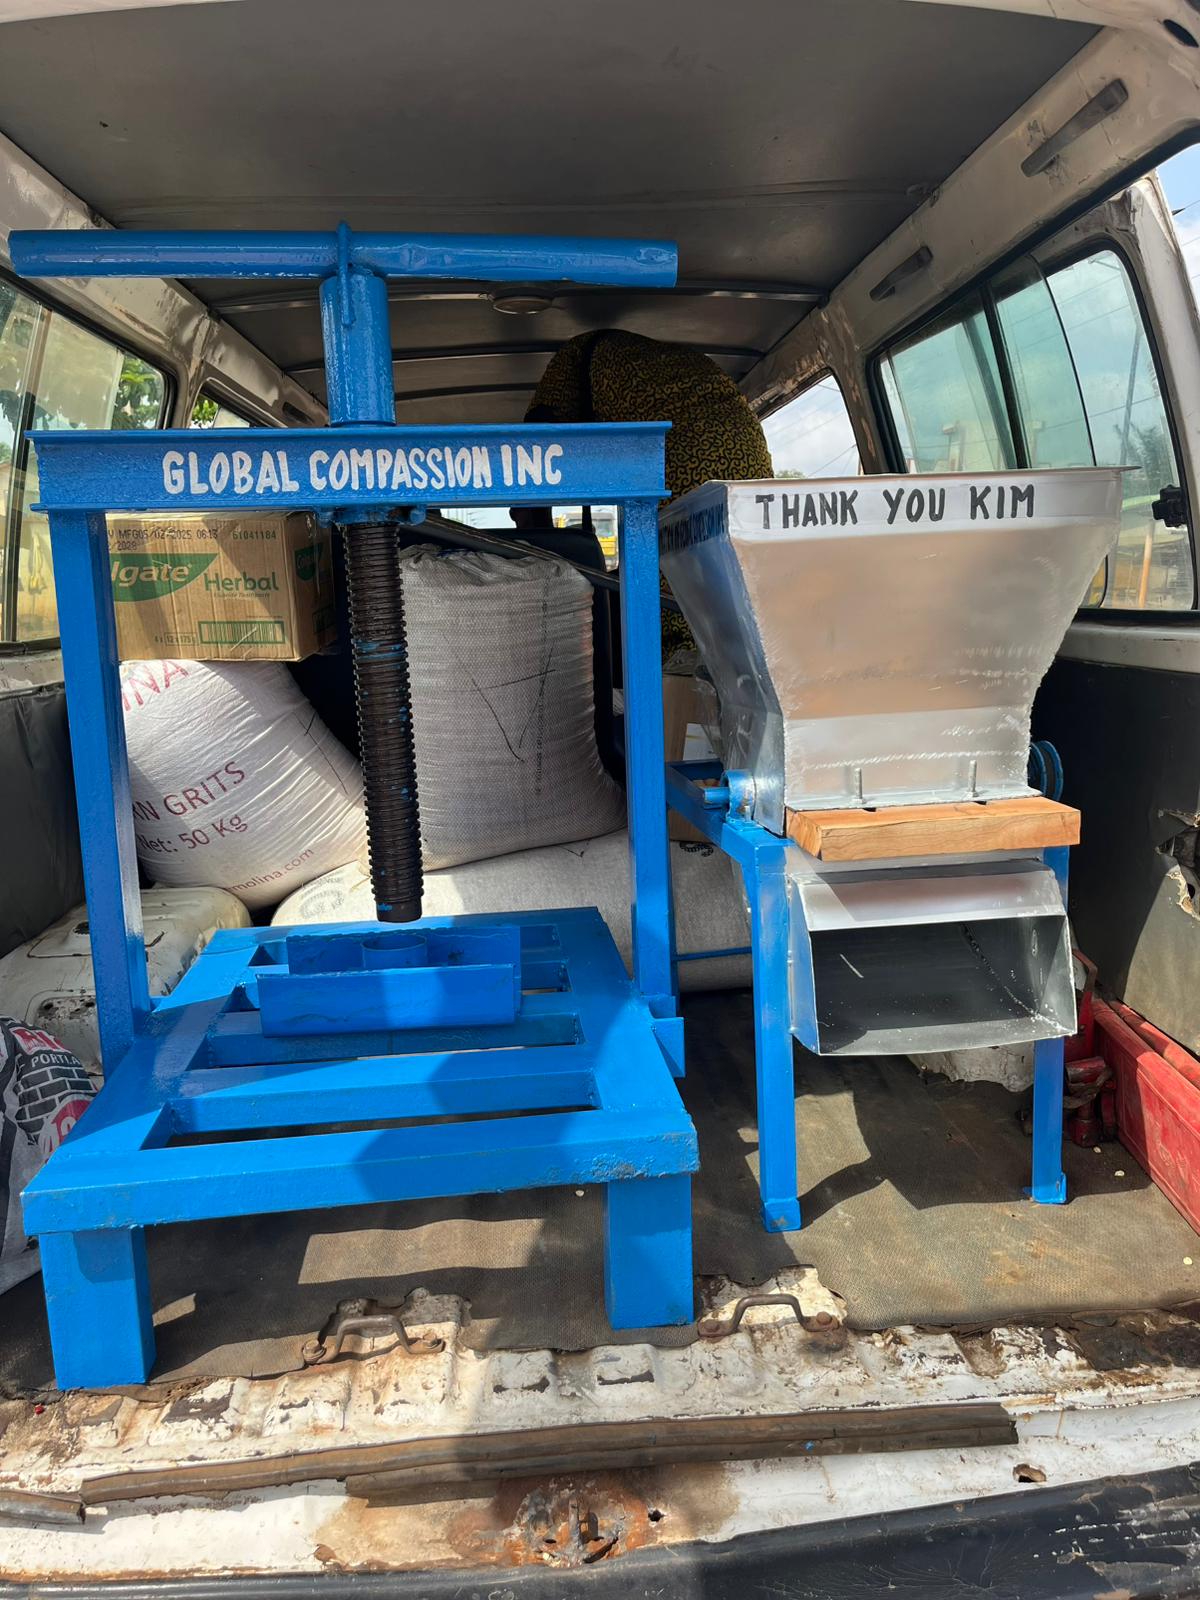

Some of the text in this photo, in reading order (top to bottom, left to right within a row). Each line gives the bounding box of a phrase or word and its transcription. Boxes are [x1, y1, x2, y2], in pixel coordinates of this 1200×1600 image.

[162, 444, 564, 495] GLOBAL COMPASSION INC
[755, 489, 859, 530] THANK
[882, 487, 946, 525] YOU
[969, 484, 1035, 520] KIM
[203, 571, 279, 592] Herbal
[163, 761, 245, 816] GRITS
[136, 814, 249, 853] Net: 50 Kg
[228, 848, 315, 892] molina.com
